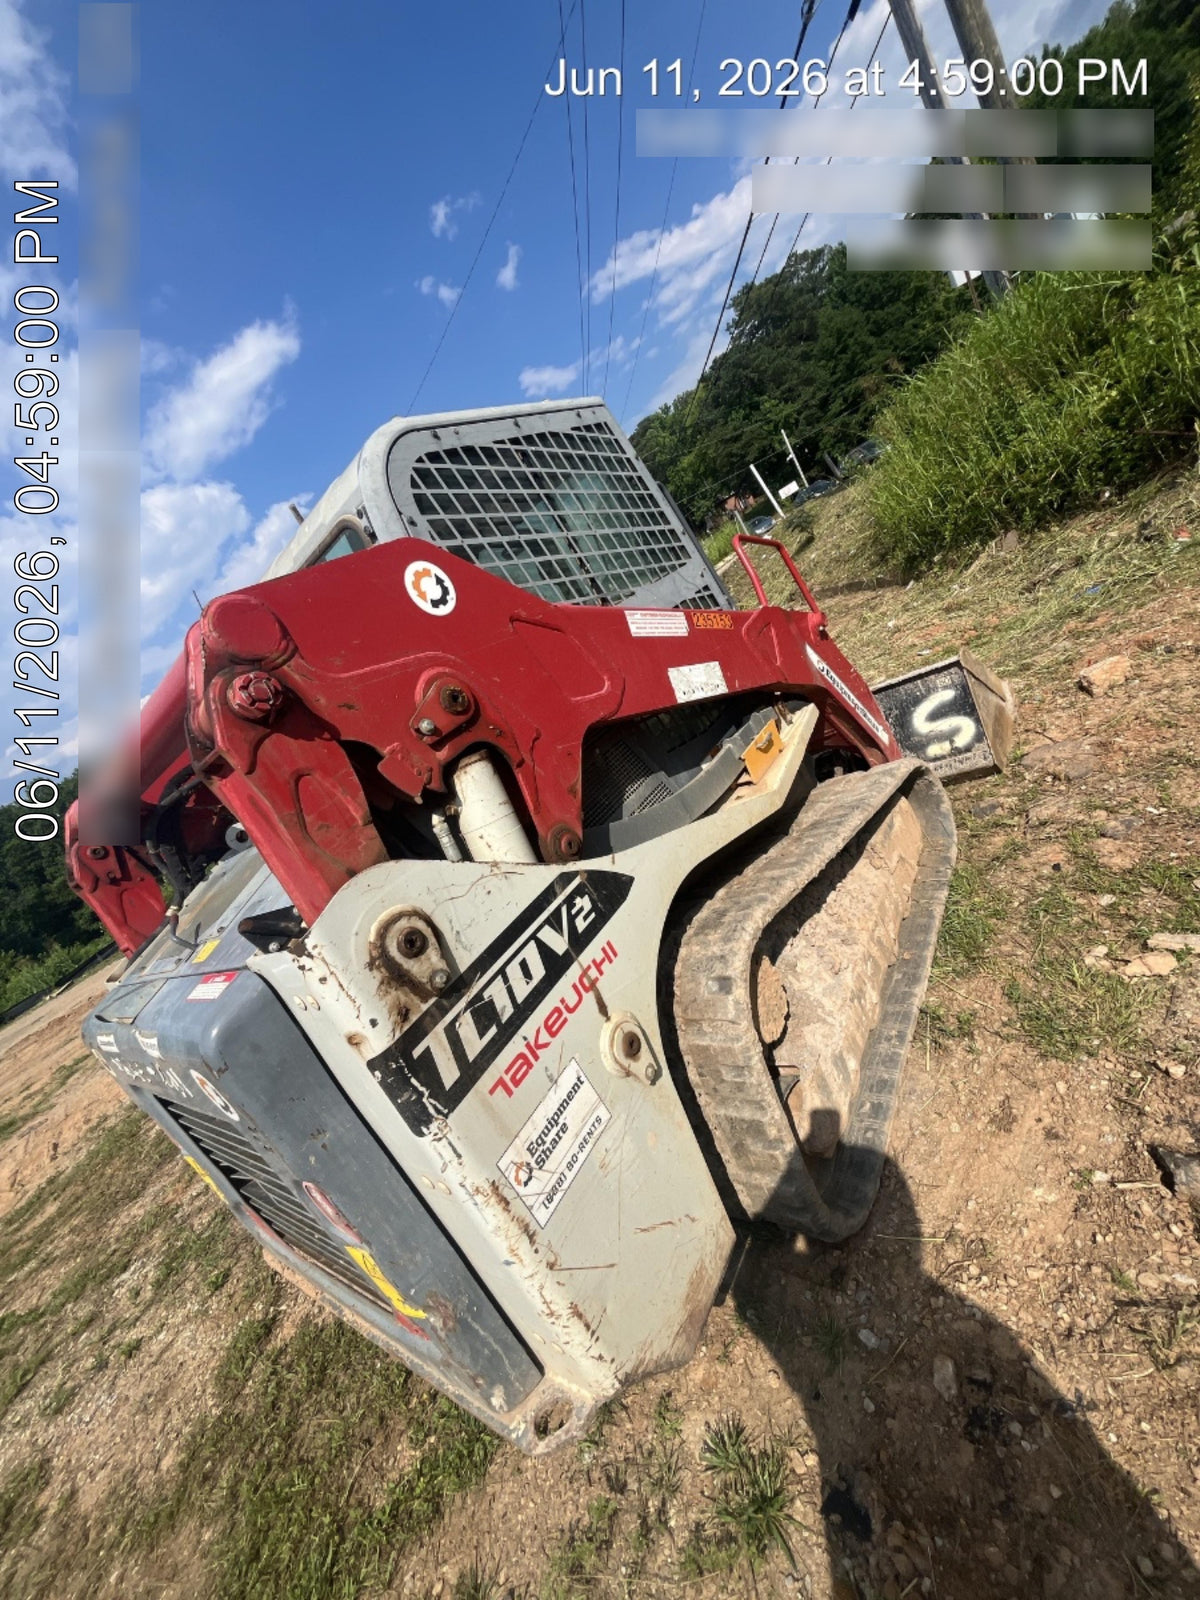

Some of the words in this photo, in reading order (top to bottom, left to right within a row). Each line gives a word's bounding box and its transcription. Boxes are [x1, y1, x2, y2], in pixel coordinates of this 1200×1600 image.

[911, 687, 976, 759] S
[526, 1074, 585, 1158] Equipment
[534, 1121, 569, 1171] Share
[566, 1115, 603, 1172] 80-RENTS
